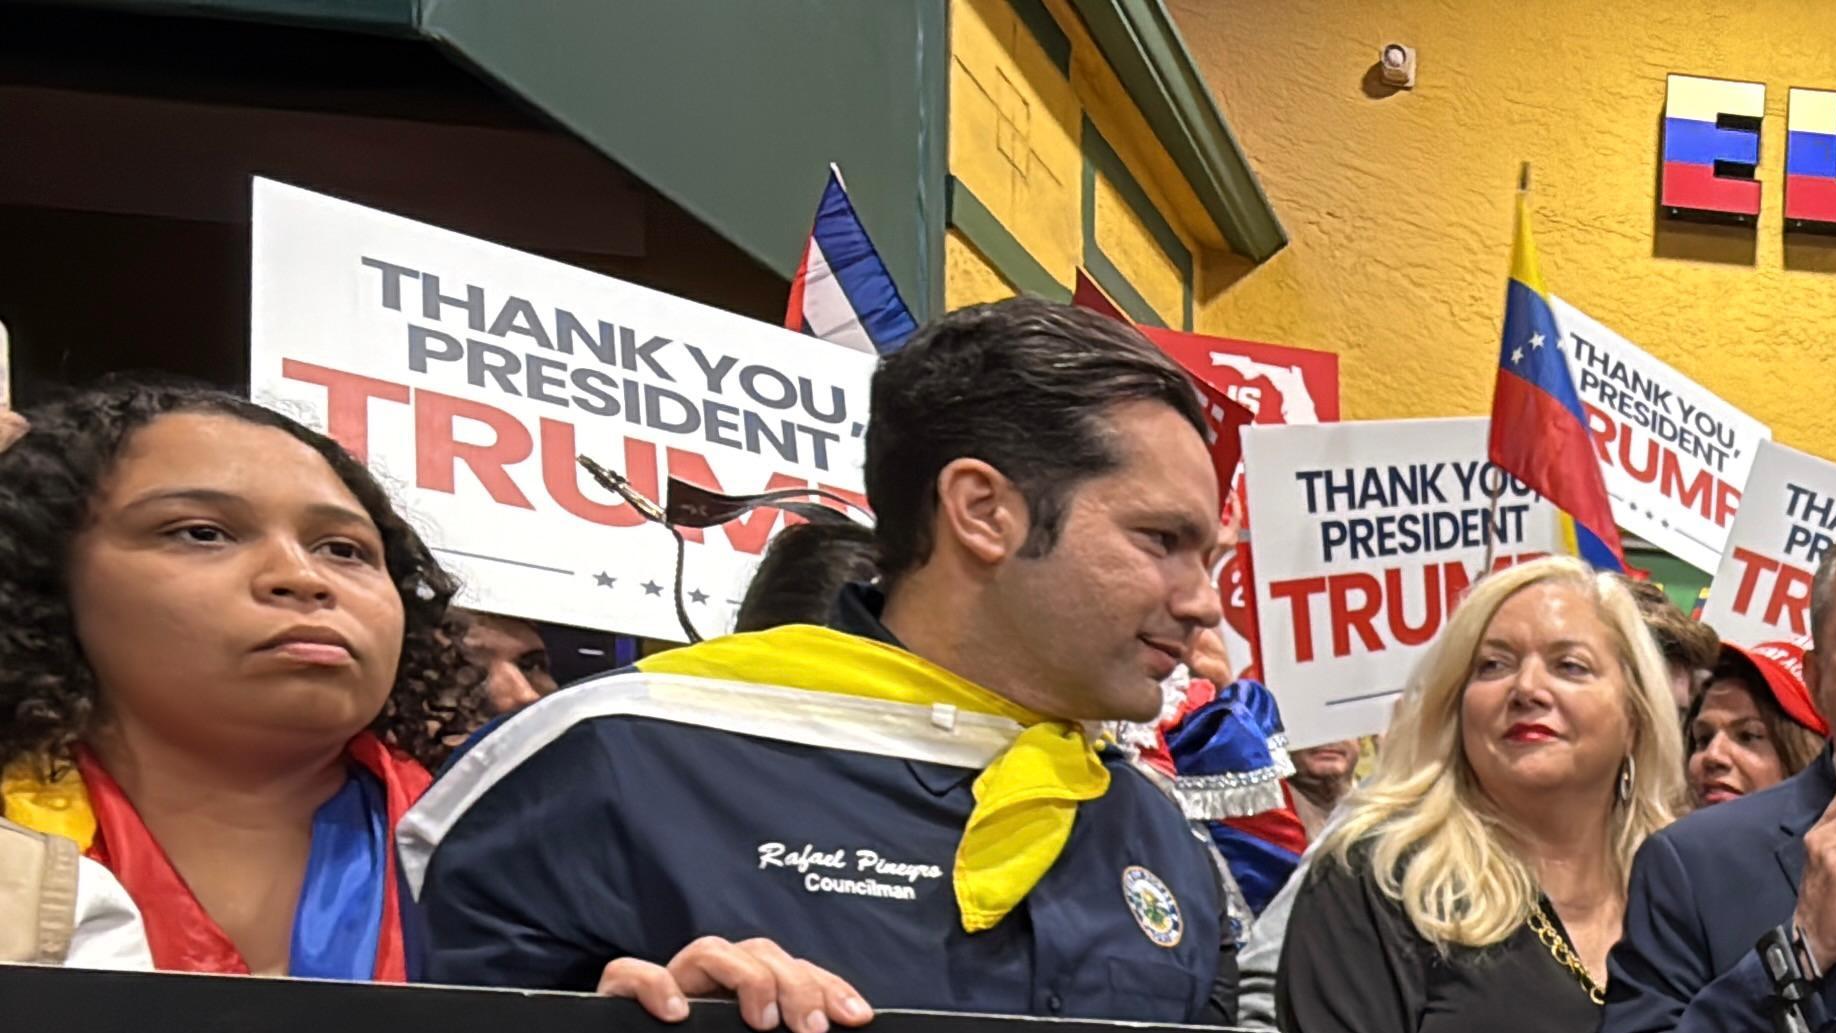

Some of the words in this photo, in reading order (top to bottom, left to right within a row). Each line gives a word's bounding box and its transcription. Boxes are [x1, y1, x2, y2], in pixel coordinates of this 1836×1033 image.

[361, 256, 677, 383] THANK
[683, 343, 865, 438] YOU,
[407, 324, 840, 472] PRESIDENT
[1570, 332, 1672, 415] THANK
[1677, 396, 1741, 459] YOU,
[1580, 368, 1729, 472] PRESIDENT
[1580, 400, 1742, 528] RUMP
[1295, 463, 1448, 514] THANK
[1321, 504, 1530, 563] PRESIDENT
[1269, 552, 1553, 663] TRU
[758, 842, 846, 873] Rafael
[804, 873, 917, 900] Councilman
